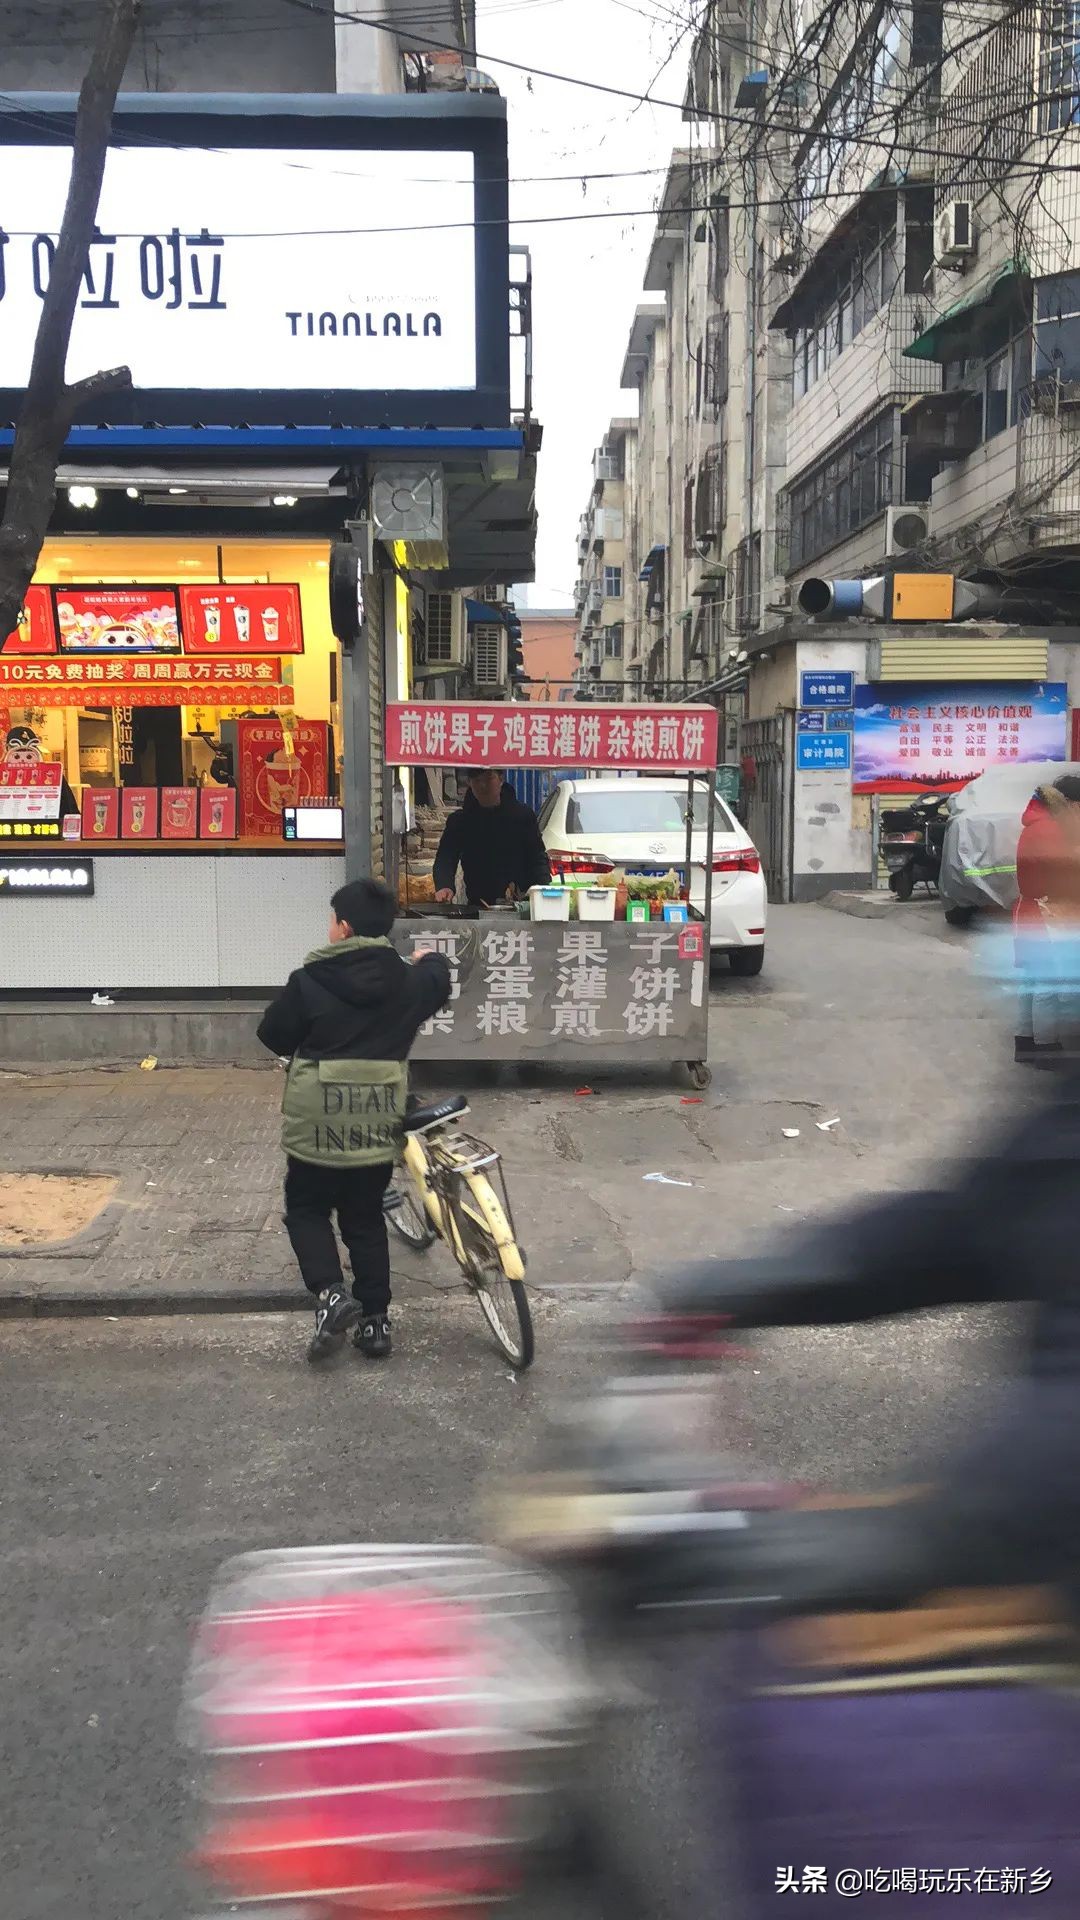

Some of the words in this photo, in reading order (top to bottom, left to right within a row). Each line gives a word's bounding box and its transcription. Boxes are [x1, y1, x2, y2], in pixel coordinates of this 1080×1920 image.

[285, 311, 442, 337] TIANLALA
[2, 663, 125, 680] 10元免费抽奖
[132, 663, 274, 679] 周周赢万元现金
[889, 705, 1033, 719] 社会主义核心价值观
[398, 710, 498, 756] 煎饼果子
[503, 712, 601, 758] 鸡蛋灌饼
[607, 715, 705, 761] 杂粮煎饼
[900, 723, 920, 733] 富强
[932, 723, 953, 733] 民主
[966, 723, 987, 733] 文明
[998, 723, 1019, 733] 和谐
[900, 736, 920, 745] 自由
[932, 735, 953, 745] 平等
[966, 735, 986, 745] 公正
[998, 735, 1019, 744] 法治
[899, 747, 920, 757] 爱国
[932, 747, 953, 757] 敬业
[965, 747, 986, 757] 诚信
[998, 747, 1019, 757] 友善
[323, 1084, 397, 1114] DEAR
